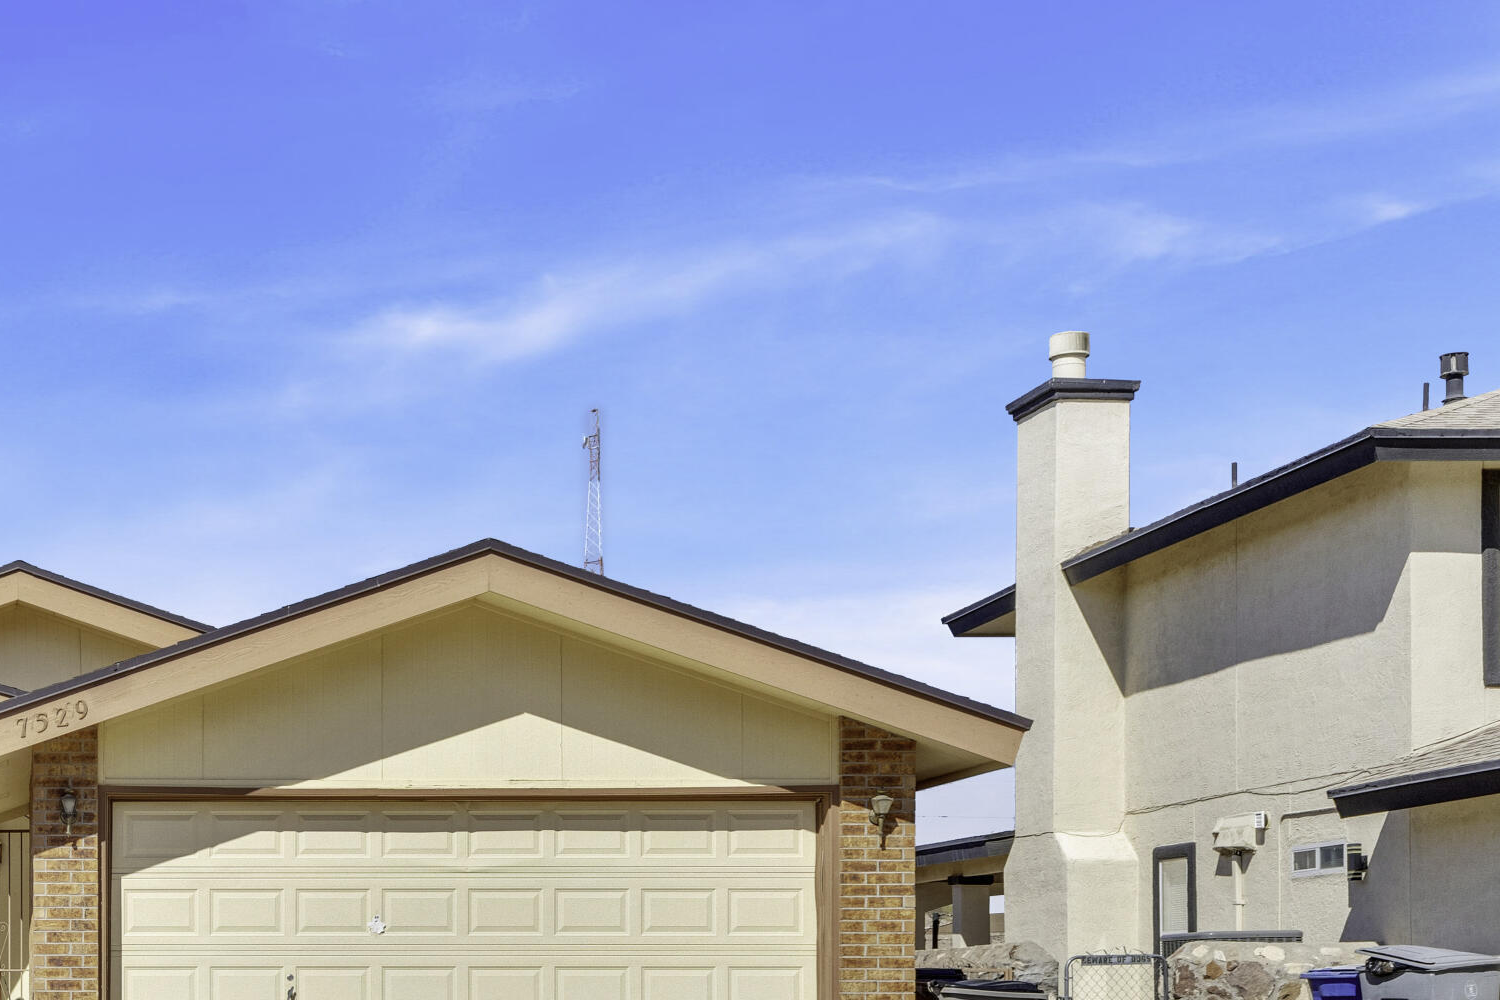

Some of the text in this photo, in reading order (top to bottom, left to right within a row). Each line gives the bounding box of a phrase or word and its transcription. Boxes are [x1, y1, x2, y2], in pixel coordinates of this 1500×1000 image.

[16, 700, 89, 738] 7529
[1082, 955, 1151, 964] BEWARE OF DOGS
